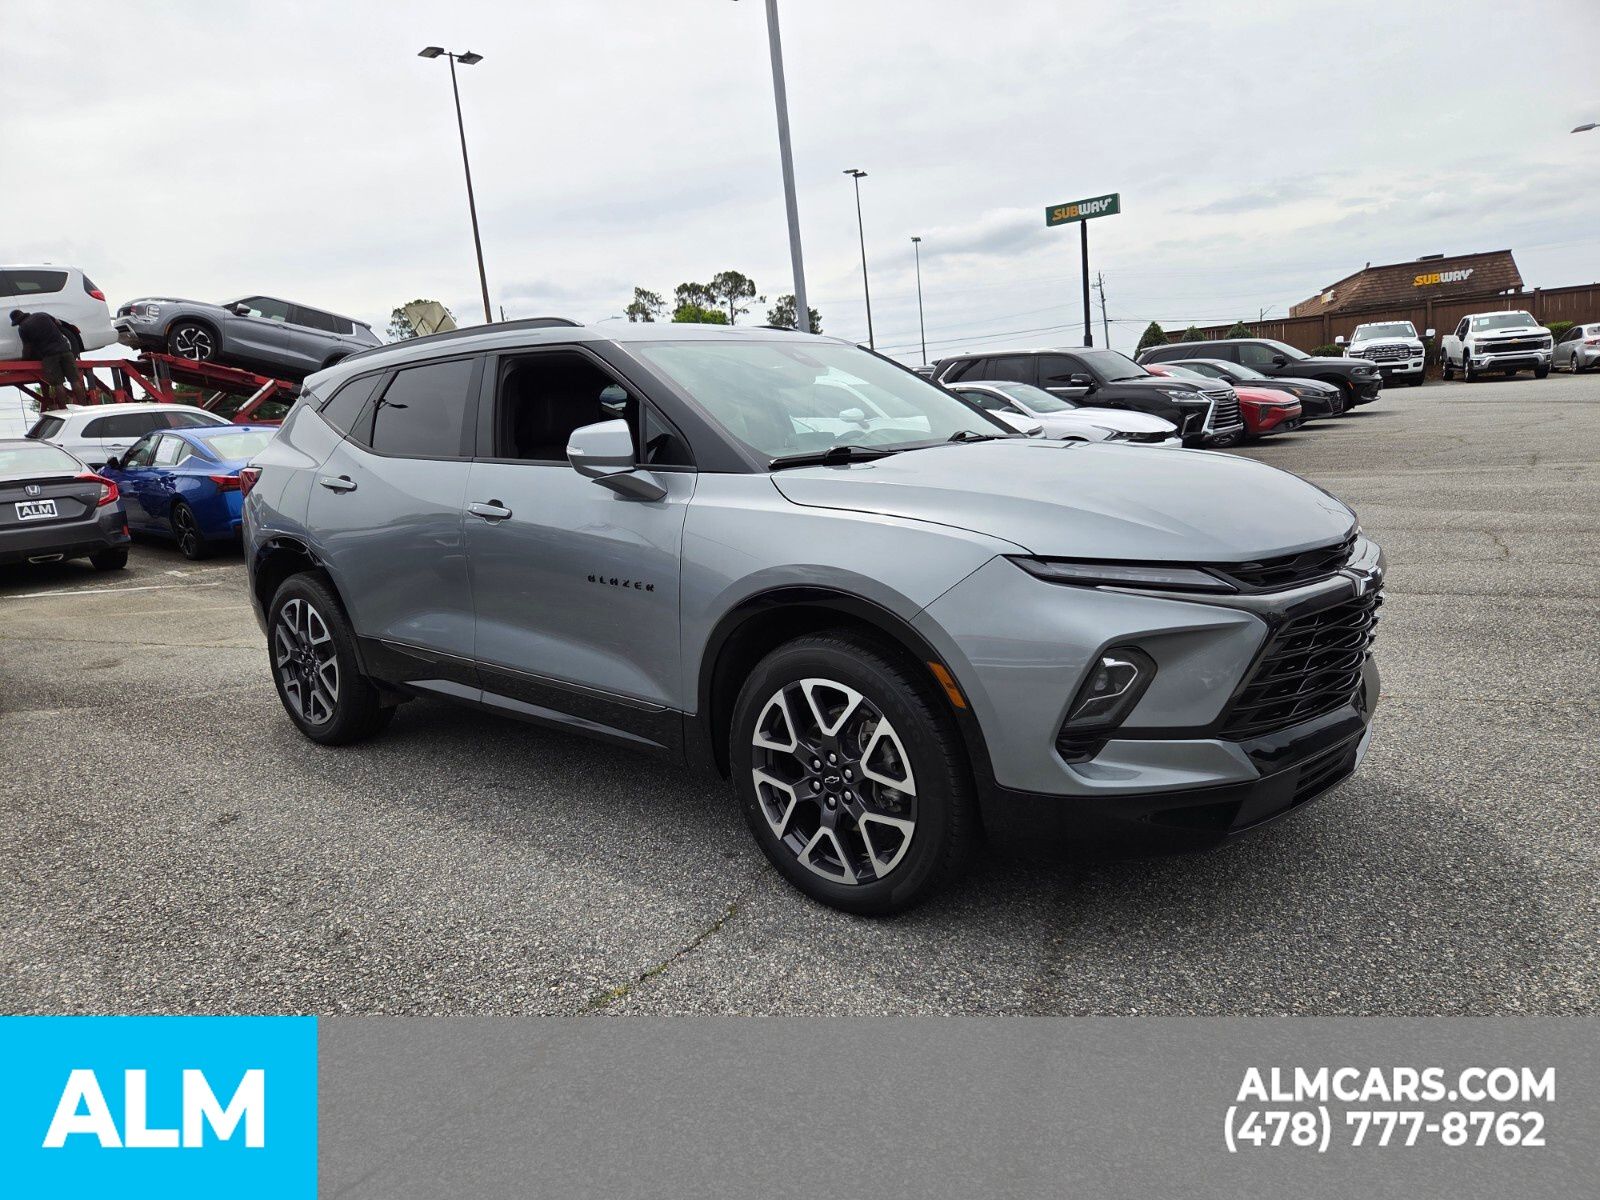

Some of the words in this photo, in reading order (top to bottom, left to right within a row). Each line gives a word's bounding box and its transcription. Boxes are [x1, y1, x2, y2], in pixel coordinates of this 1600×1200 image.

[1052, 197, 1112, 221] SUBWAY
[1412, 268, 1474, 286] SUBWAY
[22, 504, 52, 516] ALM
[587, 574, 655, 592] BLAZER
